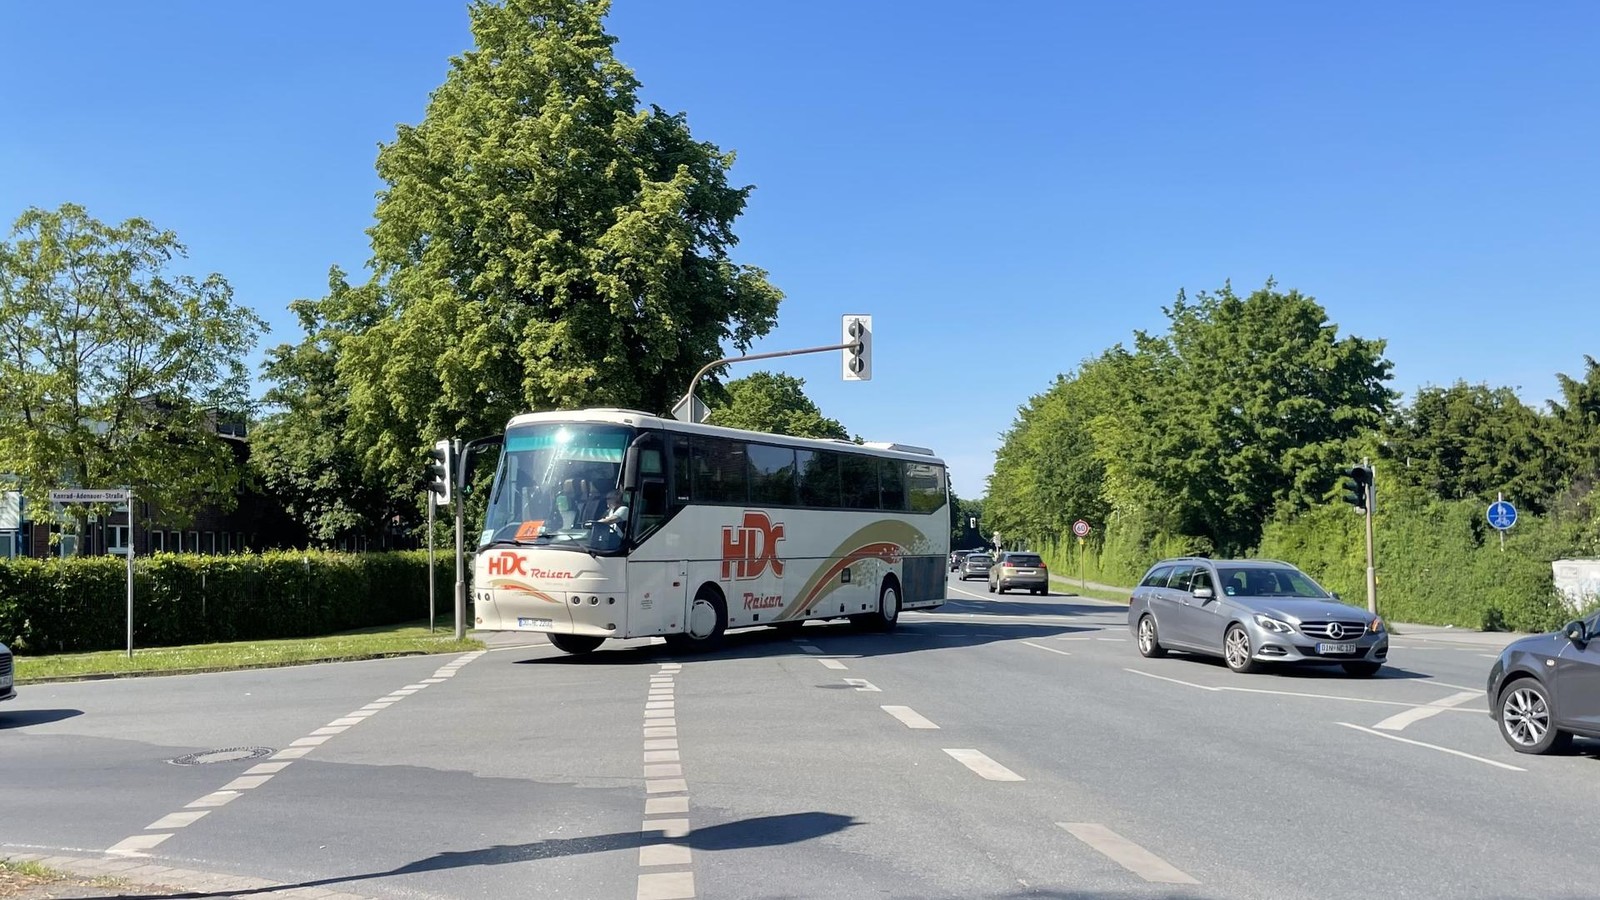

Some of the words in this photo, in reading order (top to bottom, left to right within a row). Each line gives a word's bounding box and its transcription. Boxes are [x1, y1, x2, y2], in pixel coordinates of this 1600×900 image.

[53, 492, 124, 500] Konrad-Adenauer-Straße
[720, 509, 785, 581] HDC
[488, 551, 527, 576] HDC
[530, 568, 574, 579] Reisen
[743, 592, 784, 610] Reisen
